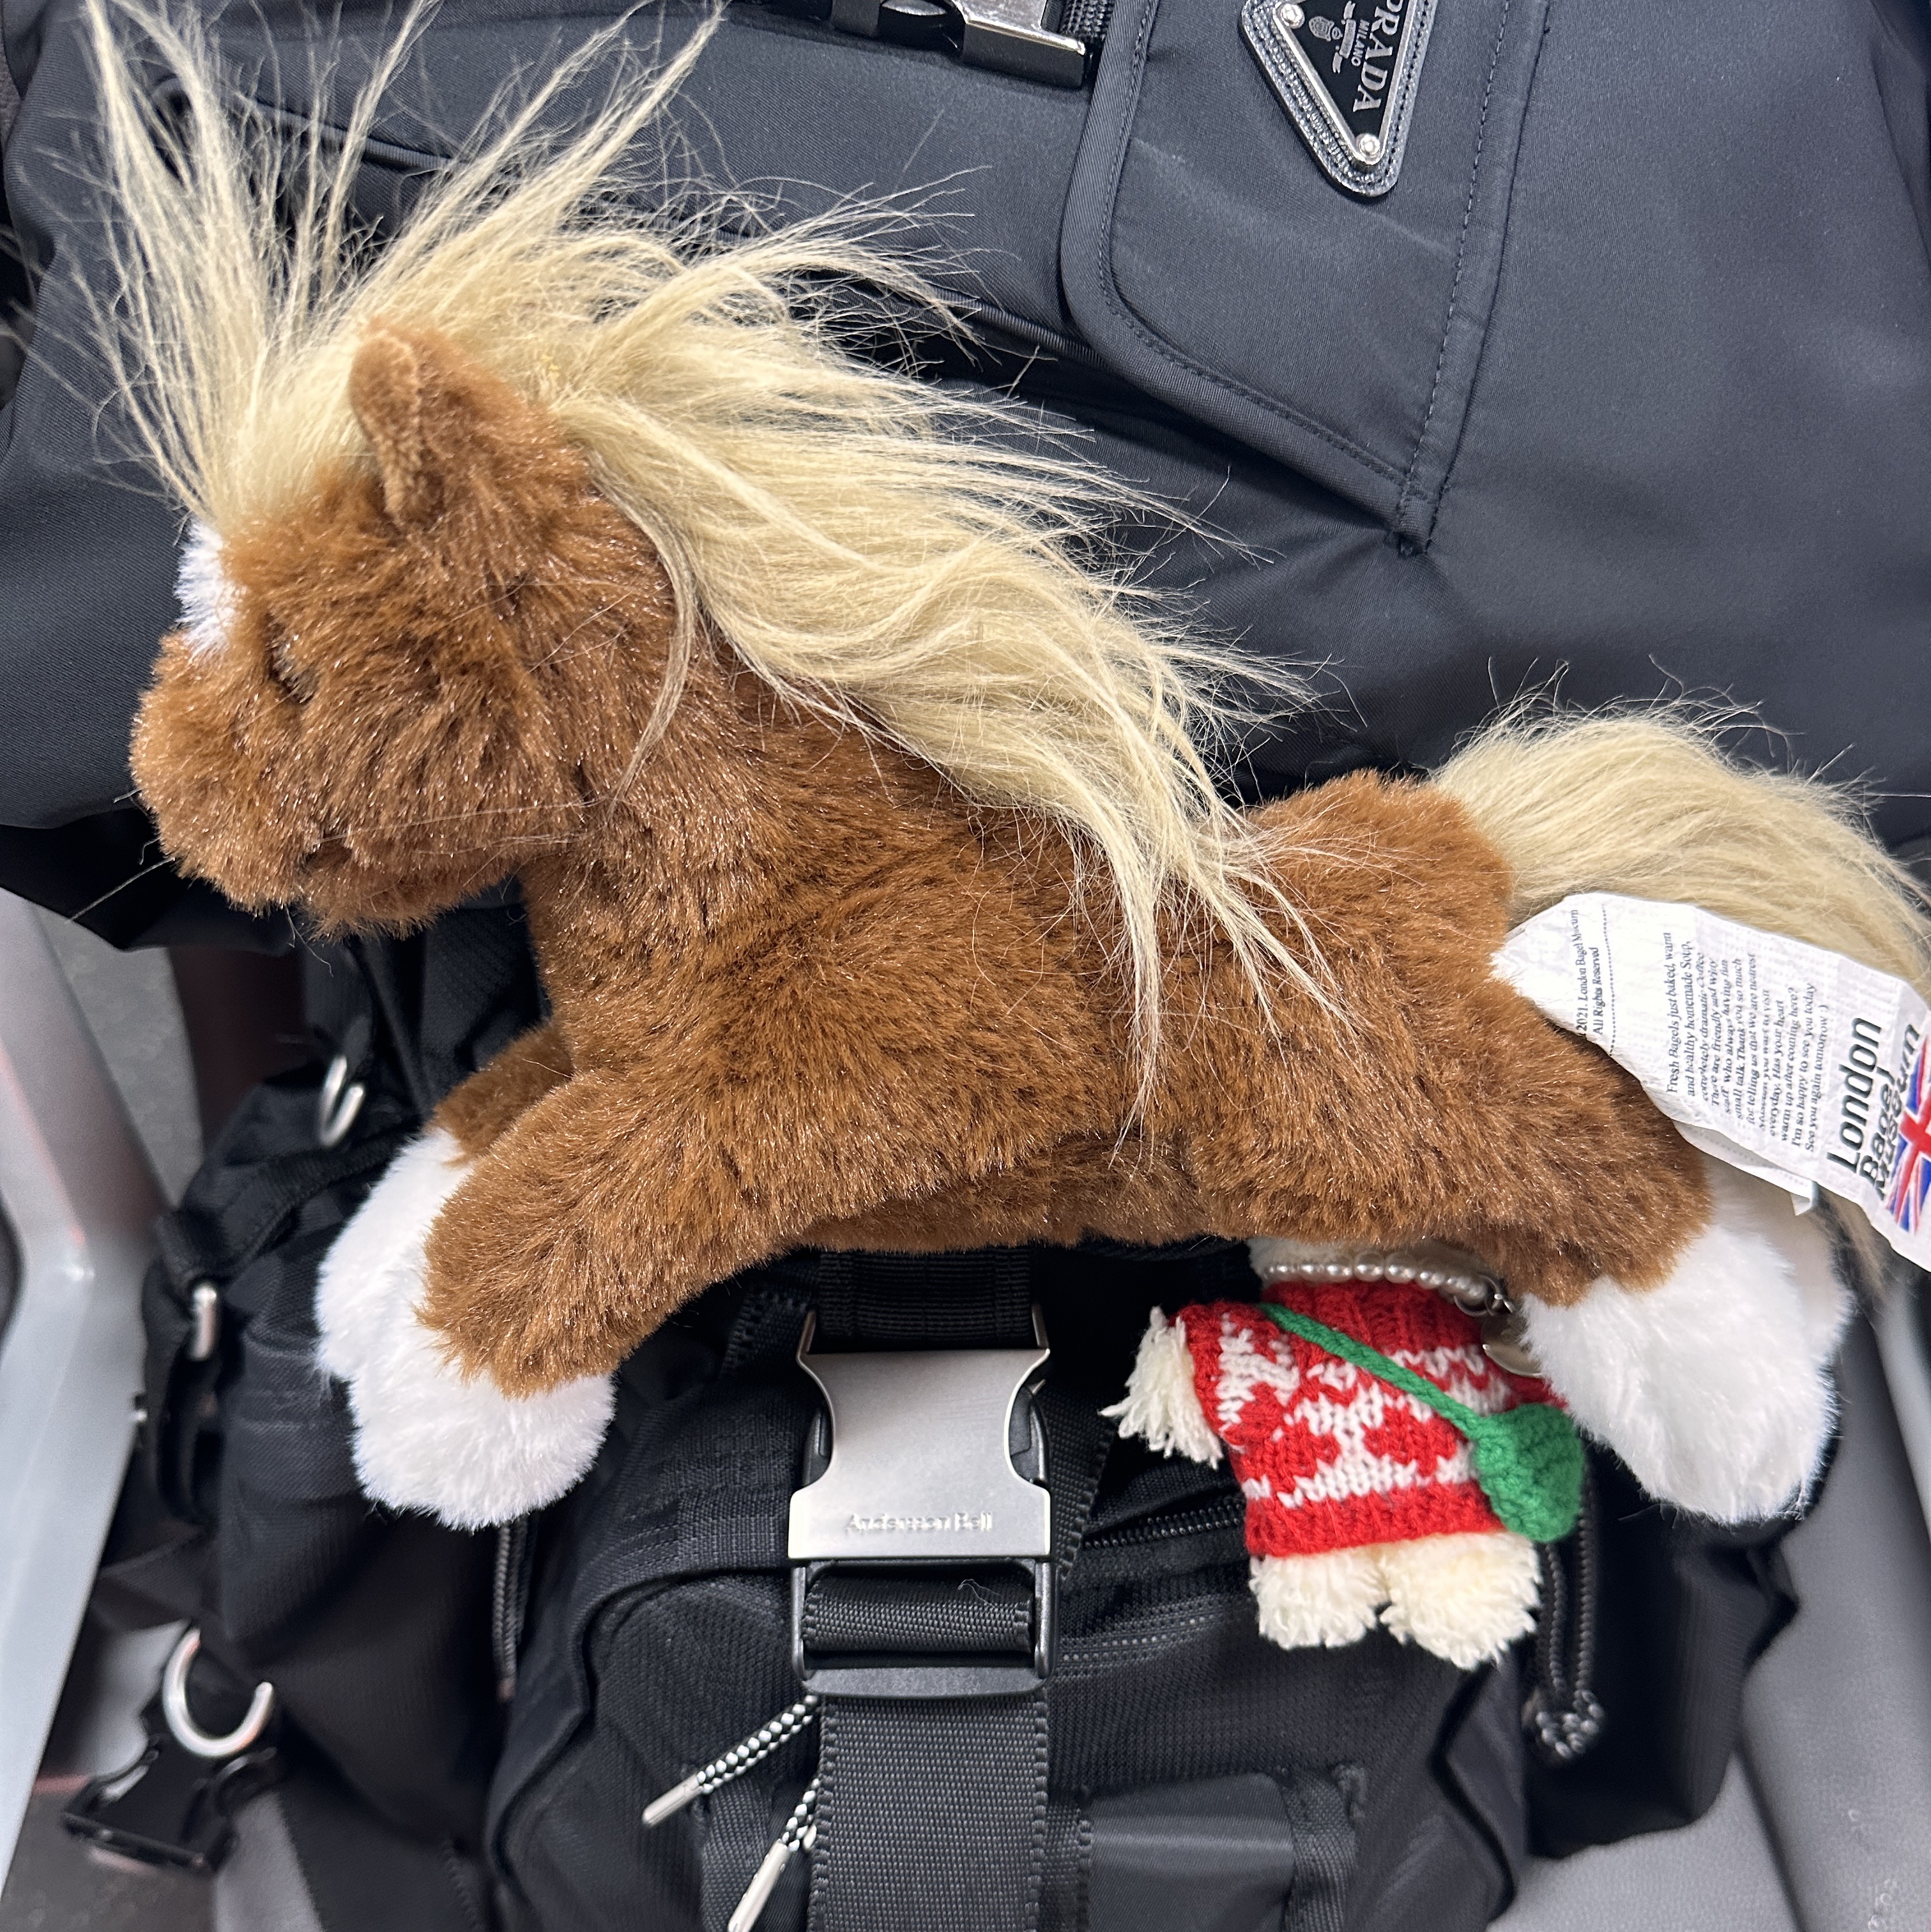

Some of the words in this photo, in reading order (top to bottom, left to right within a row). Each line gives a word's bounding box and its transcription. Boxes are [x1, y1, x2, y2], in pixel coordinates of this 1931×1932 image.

[1351, 19, 1370, 66] MILANO
[1573, 943, 1587, 965] Bagel
[1663, 932, 1673, 960] warm
[1679, 941, 1693, 969] Soup,
[1589, 947, 1602, 985] Reserved
[1664, 963, 1675, 996] baked,
[1696, 953, 1704, 988] Coffee
[1732, 959, 1742, 987] much
[1748, 954, 1757, 991] nearest
[1577, 968, 1588, 1001] London
[1708, 987, 1718, 1007] and
[1720, 979, 1732, 1015] having
[1737, 991, 1743, 1002] so
[1592, 988, 1605, 1017] Rights
[1667, 998, 1682, 1021] just
[1681, 972, 1694, 1030] homemade
[1762, 989, 1772, 1011] visit
[1788, 987, 1798, 1017] here?
[1803, 984, 1817, 1014] today
[1575, 1003, 1588, 1031] 2021.
[1592, 1020, 1603, 1035] All
[1698, 990, 1707, 1038] dramatic
[1736, 1005, 1744, 1026] you
[1749, 1012, 1756, 1028] we
[1762, 1015, 1769, 1026] to
[1773, 1000, 1785, 1027] heart
[1668, 1021, 1681, 1058] Bagels
[1711, 1009, 1722, 1052] friendly
[1725, 1018, 1735, 1056] always
[1749, 1031, 1757, 1051] that
[1787, 1019, 1801, 1061] coming
[1804, 1017, 1813, 1039] you
[1684, 1032, 1697, 1073] healthy
[1736, 1027, 1745, 1060] Thank
[1774, 1028, 1783, 1057] your
[1801, 1040, 1810, 1058] see
[1814, 1016, 1828, 1070] tomorrow
[1698, 1040, 1710, 1101] completely
[1712, 1055, 1720, 1073] are
[1723, 1058, 1732, 1083] who
[1736, 1063, 1745, 1086] talk.
[1751, 1054, 1757, 1067] us
[1763, 1058, 1771, 1081] you
[1772, 1058, 1780, 1079] Has
[1799, 1061, 1808, 1072] to
[1666, 1061, 1679, 1093] Fresh
[1685, 1076, 1695, 1097] and
[1747, 1069, 1759, 1106] telling
[1784, 1063, 1793, 1090] after
[1810, 1074, 1821, 1104] again
[1721, 1086, 1731, 1114] staff
[1733, 1089, 1743, 1120] small
[1785, 1092, 1794, 1106] up
[1796, 1075, 1808, 1109] happy
[1826, 1017, 1881, 1174] London
[1746, 1107, 1755, 1124] for
[1769, 1083, 1782, 1136] everyday.
[1796, 1112, 1803, 1125] so
[1875, 1024, 1920, 1200] Museum
[1782, 1109, 1790, 1141] warm
[1792, 1129, 1802, 1146] I'm
[1858, 1067, 1895, 1187] Bagel
[1805, 1130, 1815, 1152] See
[955, 1510, 993, 1532] Bell
